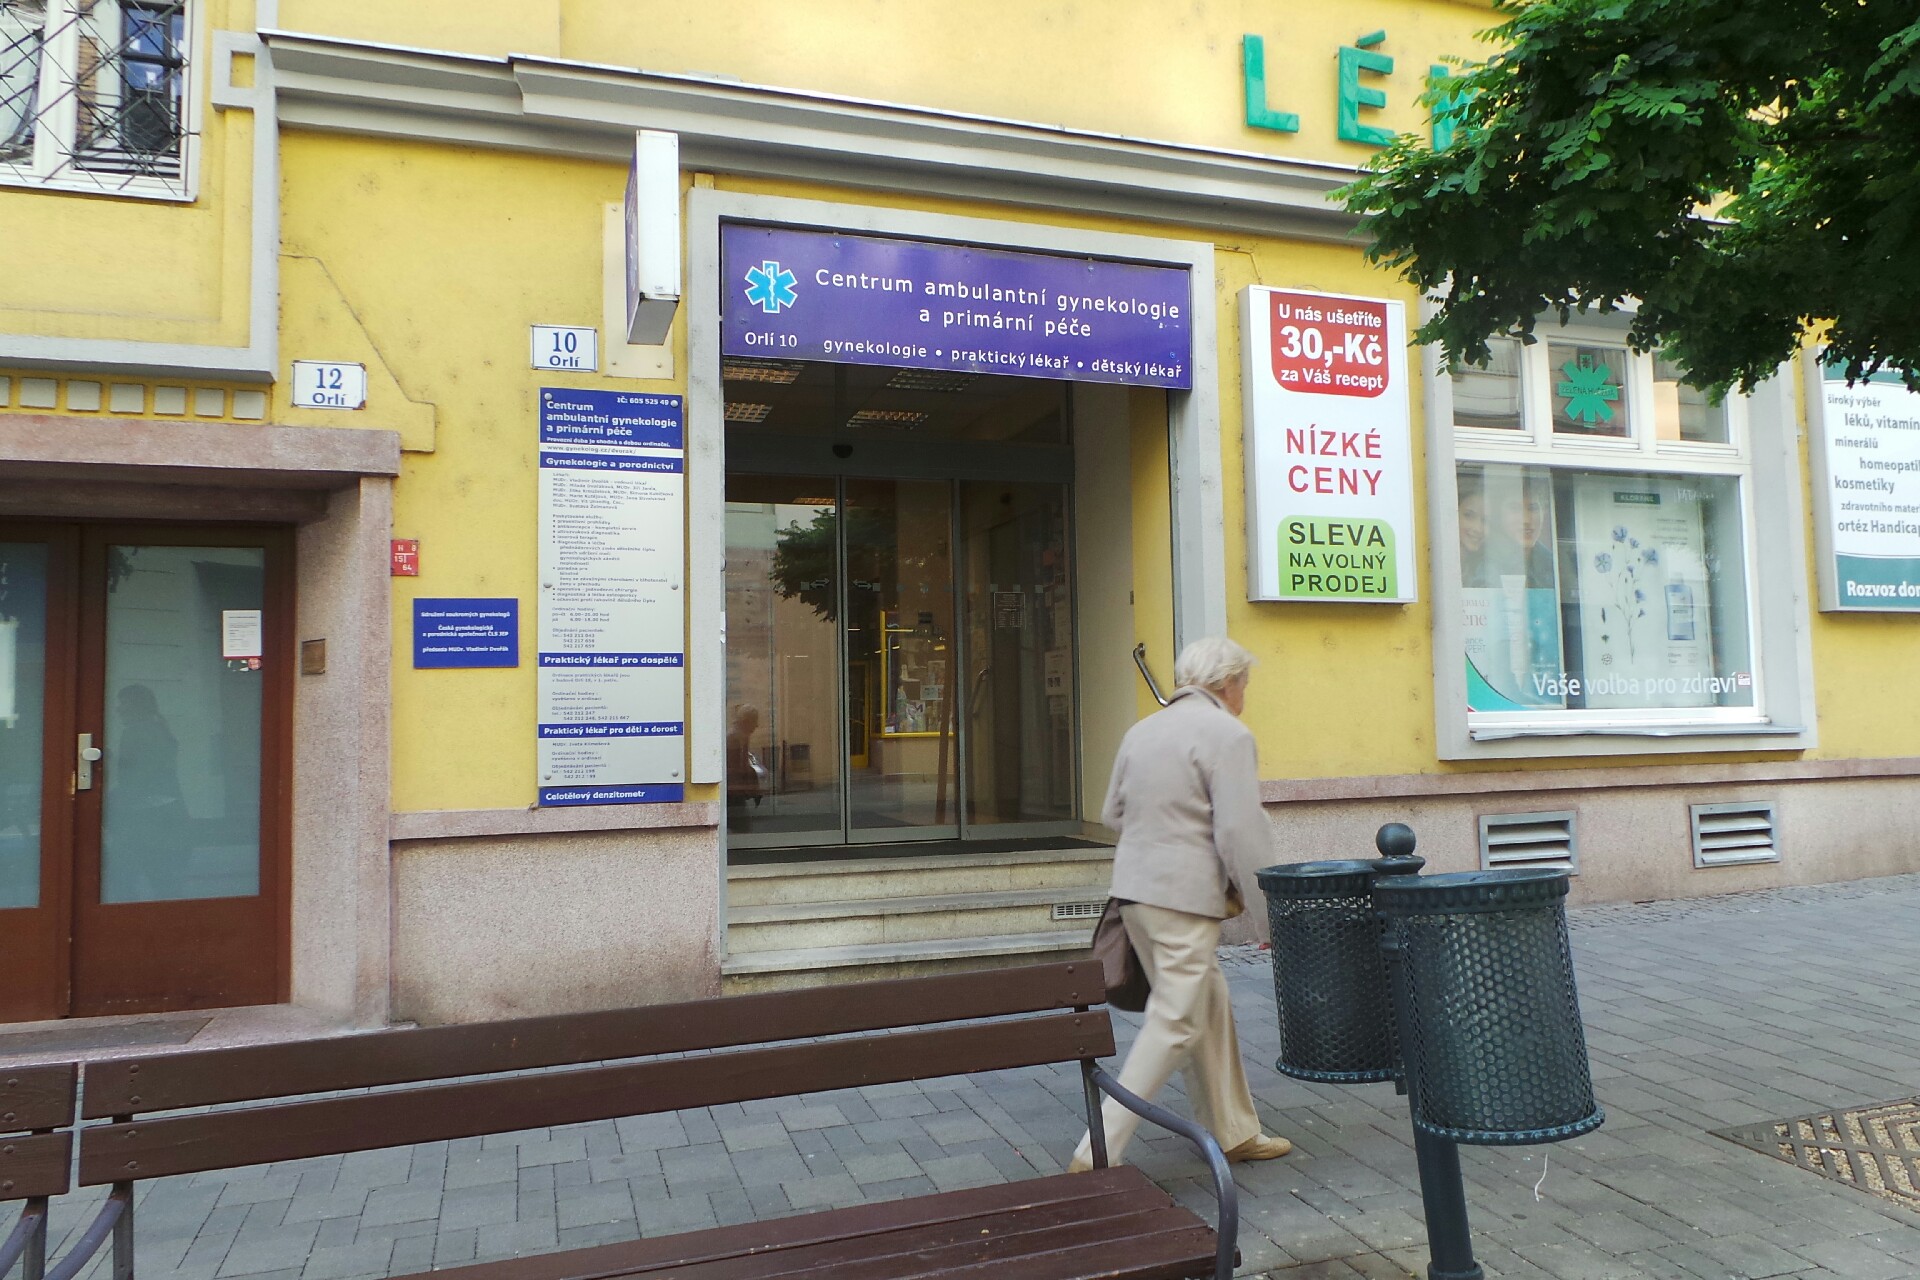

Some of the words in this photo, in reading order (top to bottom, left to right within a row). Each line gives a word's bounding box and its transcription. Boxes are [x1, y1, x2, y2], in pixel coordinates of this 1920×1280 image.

[815, 269, 913, 293] Centrum
[925, 281, 1046, 306] ambulantní
[1057, 294, 1179, 320] gynekologie
[919, 309, 930, 322] a
[943, 309, 1033, 331] primární
[1045, 317, 1091, 337] péče
[1279, 303, 1290, 319] U
[1295, 306, 1322, 322] nás
[1327, 308, 1382, 328] ušetříte
[553, 332, 577, 353] 10
[745, 332, 774, 346] Orlí
[779, 334, 798, 348] 10
[1280, 325, 1382, 368] 30,-Kč
[549, 355, 580, 368] Orlí
[823, 339, 927, 359] gynekologie
[951, 348, 1026, 368] praktický
[1029, 353, 1069, 369] lékař
[1092, 359, 1141, 377] dětský
[1145, 363, 1182, 378] lékař
[316, 368, 343, 390] 12
[1281, 369, 1298, 381] za
[1302, 368, 1331, 384] Váš
[1336, 373, 1383, 391] recept
[312, 393, 345, 406] Orlí
[547, 401, 593, 411] Centrum
[1828, 394, 1854, 407] široký
[1856, 396, 1880, 408] výběr
[547, 413, 609, 424] ambulantní
[612, 416, 677, 428] gynekologie
[1844, 413, 1873, 429] léků,
[557, 424, 603, 435] primární
[607, 427, 632, 436] péče
[1286, 424, 1382, 459] NÍZKÉ
[1835, 436, 1878, 448] minerálů
[546, 457, 608, 468] Gynekologie
[619, 461, 674, 470] porodnictví
[1288, 465, 1382, 496] CENY
[1834, 475, 1895, 494] kosmetiky
[1841, 501, 1893, 512] zdravotního
[1289, 521, 1386, 547] SLEVA
[1838, 519, 1869, 532] ortéz
[1289, 552, 1316, 568] NA
[1323, 552, 1386, 570] VOLNÝ
[1291, 574, 1387, 594] PRODEJ
[1846, 580, 1897, 597] Rozvoz
[544, 656, 591, 665] Praktický
[593, 656, 619, 664] lékař
[640, 656, 678, 665] dospělé
[1532, 673, 1581, 696] Vaše
[1584, 672, 1640, 695] volba
[1645, 678, 1677, 699] pro
[1684, 672, 1737, 694] zdraví
[544, 727, 585, 736] Praktický
[585, 726, 608, 735] lékař
[625, 726, 642, 734] děti
[651, 725, 678, 733] dorost
[545, 792, 591, 801] Celotělový
[592, 790, 646, 799] denzitometr
